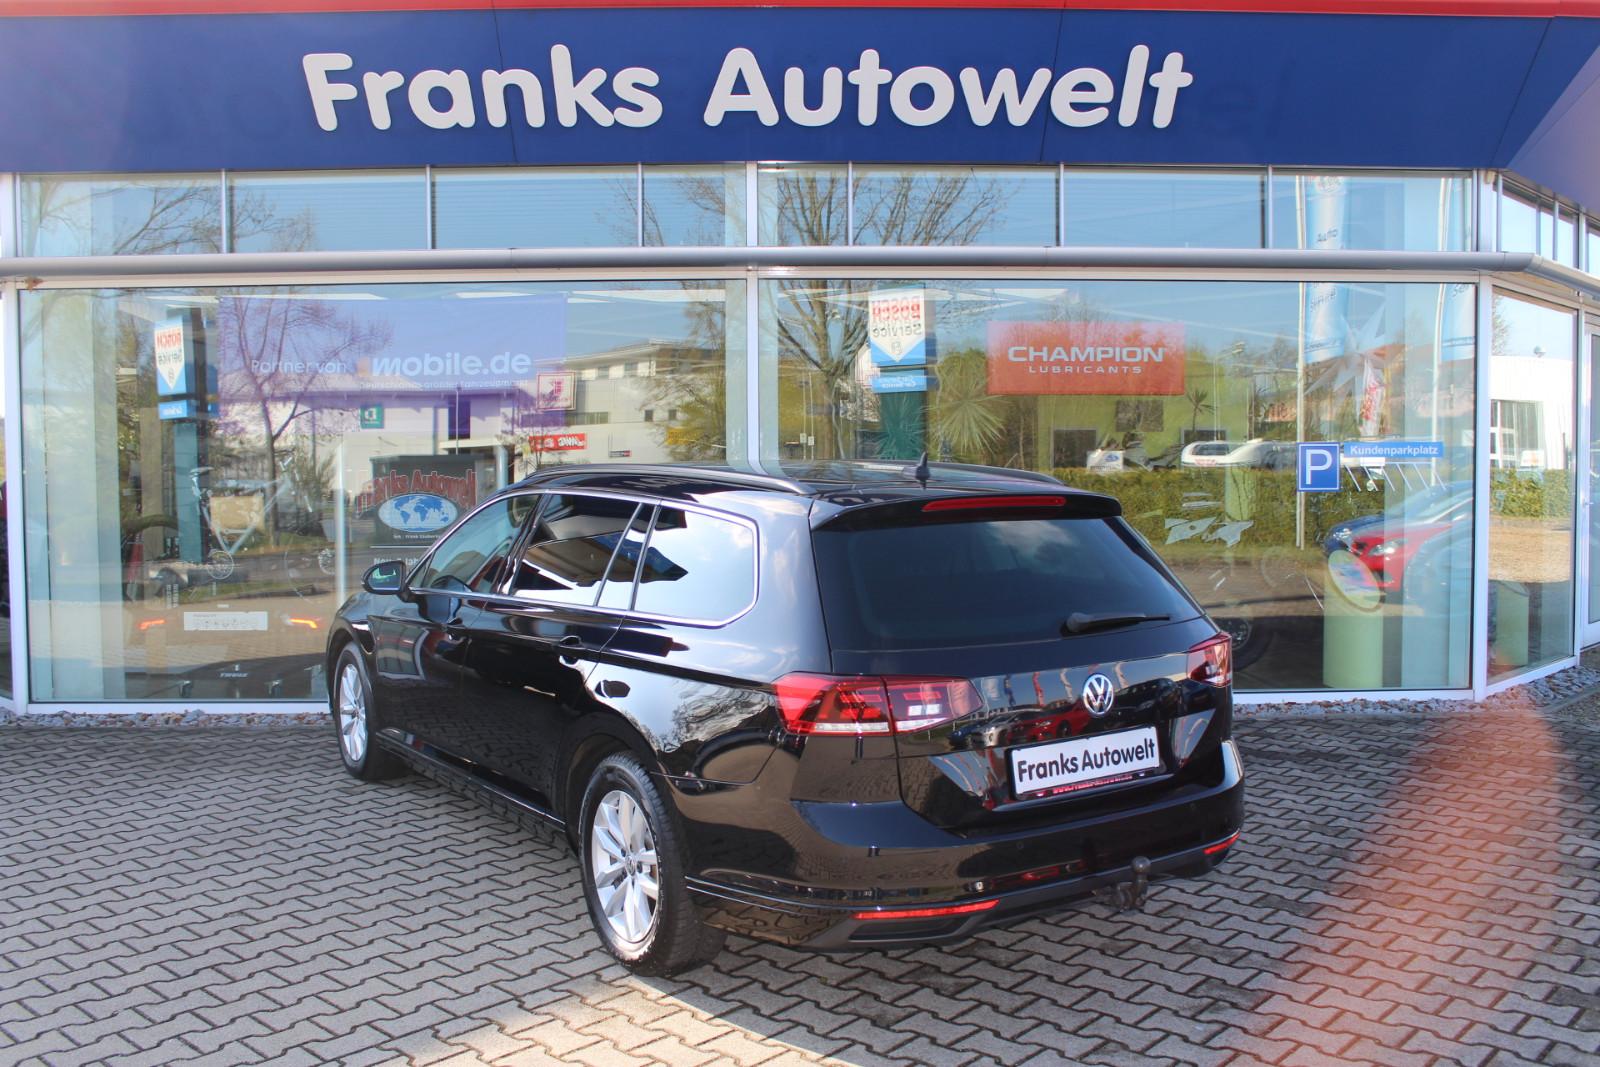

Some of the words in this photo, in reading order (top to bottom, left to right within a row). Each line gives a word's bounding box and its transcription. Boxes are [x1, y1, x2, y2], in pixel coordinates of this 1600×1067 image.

[302, 44, 663, 131] Franks
[703, 44, 1194, 129] Autowelt
[251, 358, 312, 375] Partner
[315, 363, 347, 374] von
[371, 351, 533, 378] mobile.de
[1007, 346, 1166, 363] CHAMPION
[1028, 365, 1142, 374] LUBRICANTS
[1305, 449, 1333, 485] P
[1350, 446, 1439, 457] Kundenparkplatz
[1017, 752, 1079, 783] Franks
[1081, 738, 1155, 771] Autowelt
